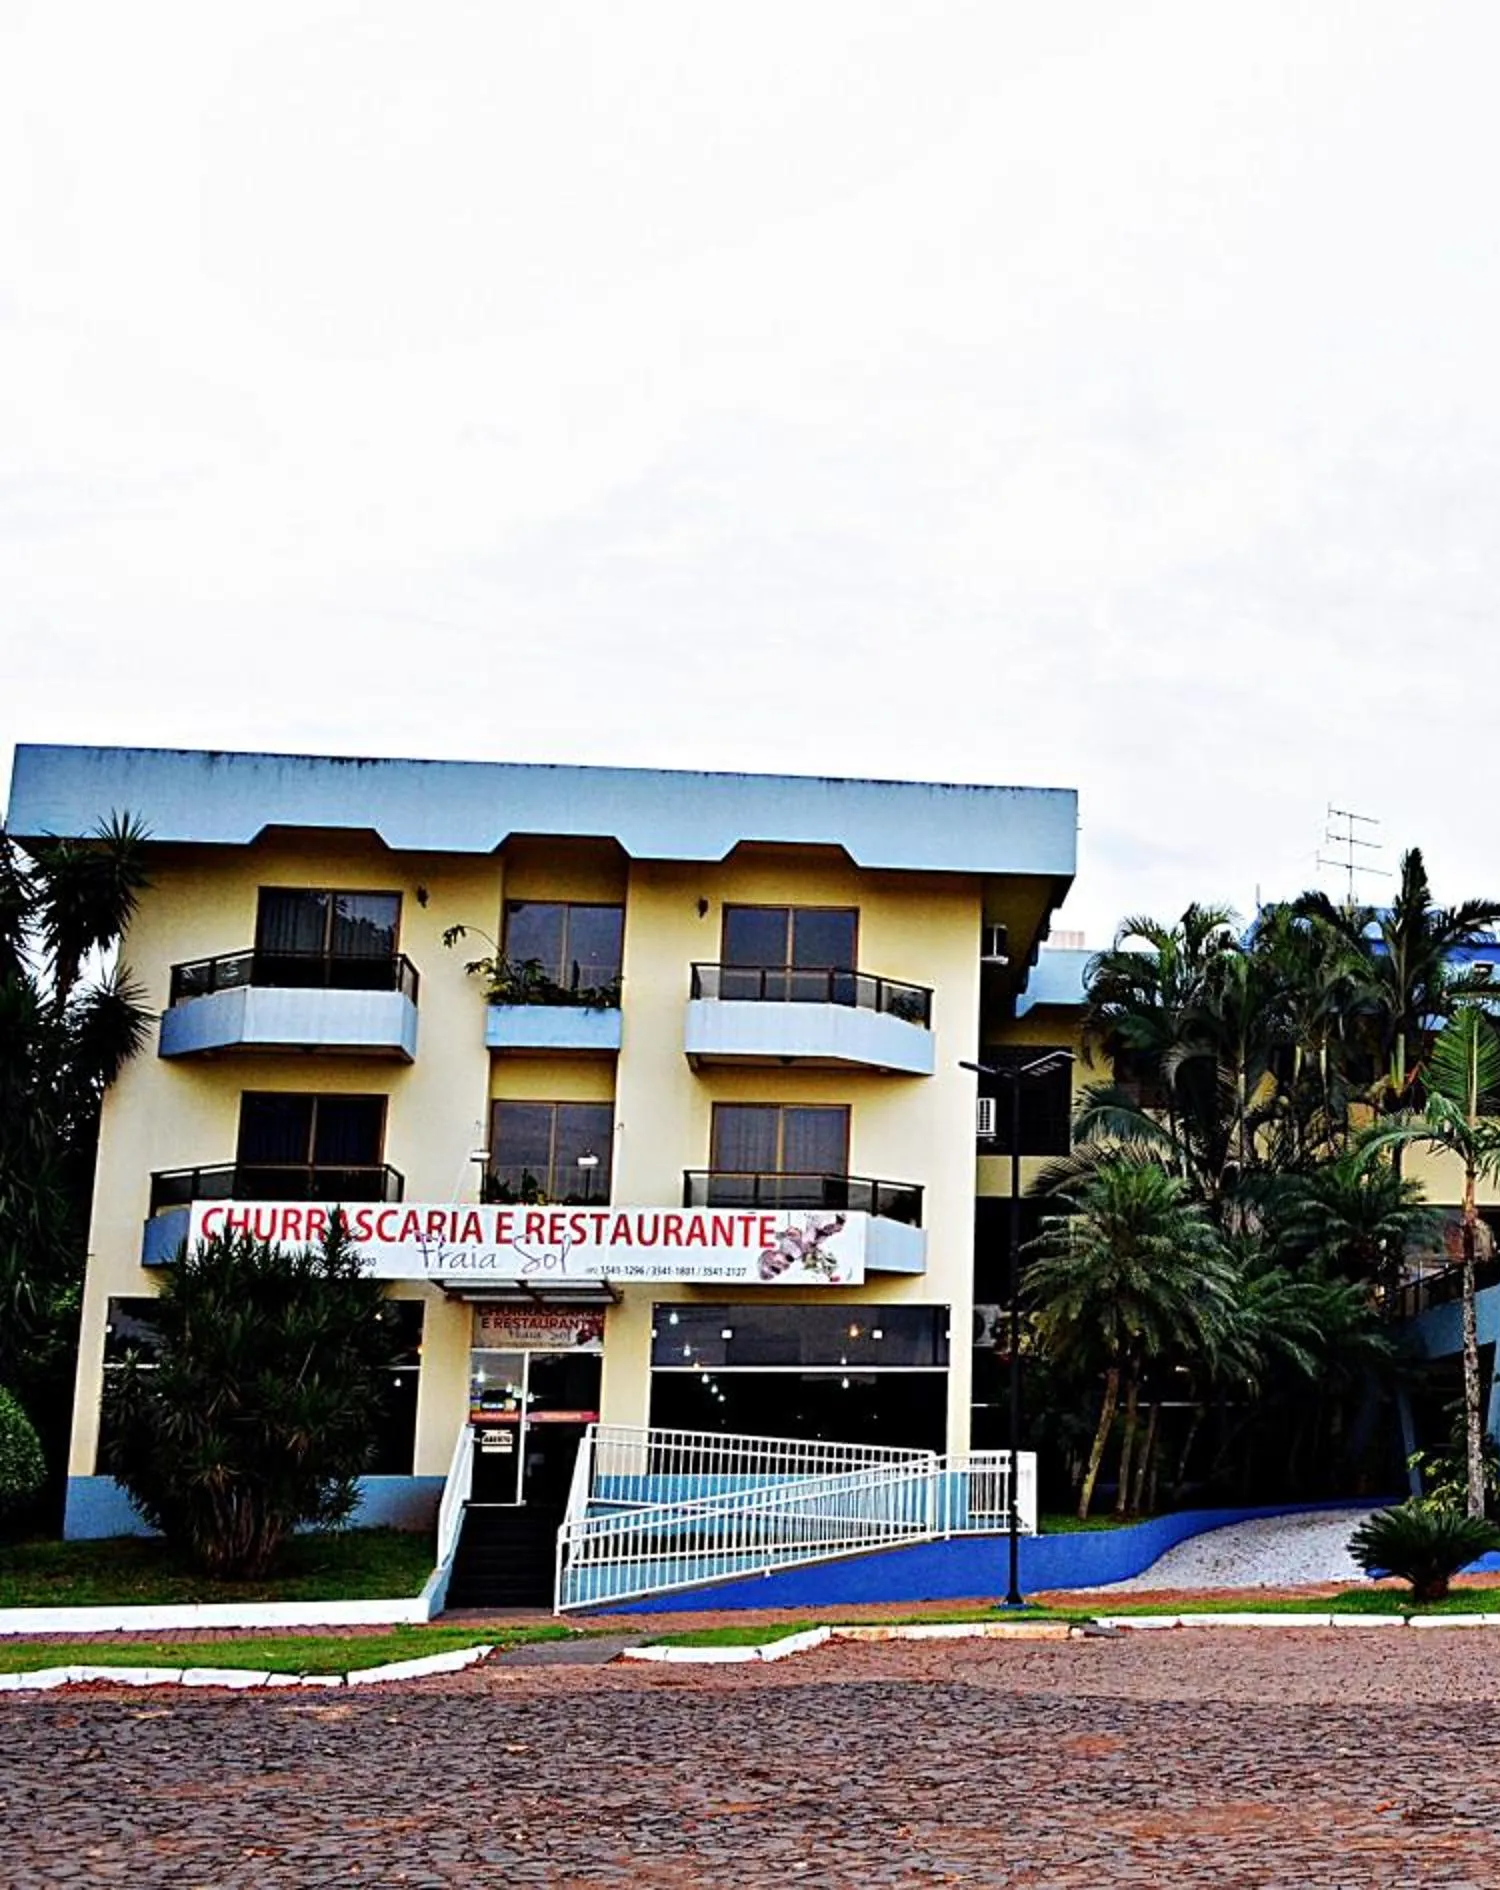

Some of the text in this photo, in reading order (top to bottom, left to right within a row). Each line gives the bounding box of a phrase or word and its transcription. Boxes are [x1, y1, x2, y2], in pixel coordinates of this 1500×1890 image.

[496, 1211, 513, 1244] E
[525, 1212, 776, 1248] RESTAURANTE
[513, 1232, 573, 1274] Sol
